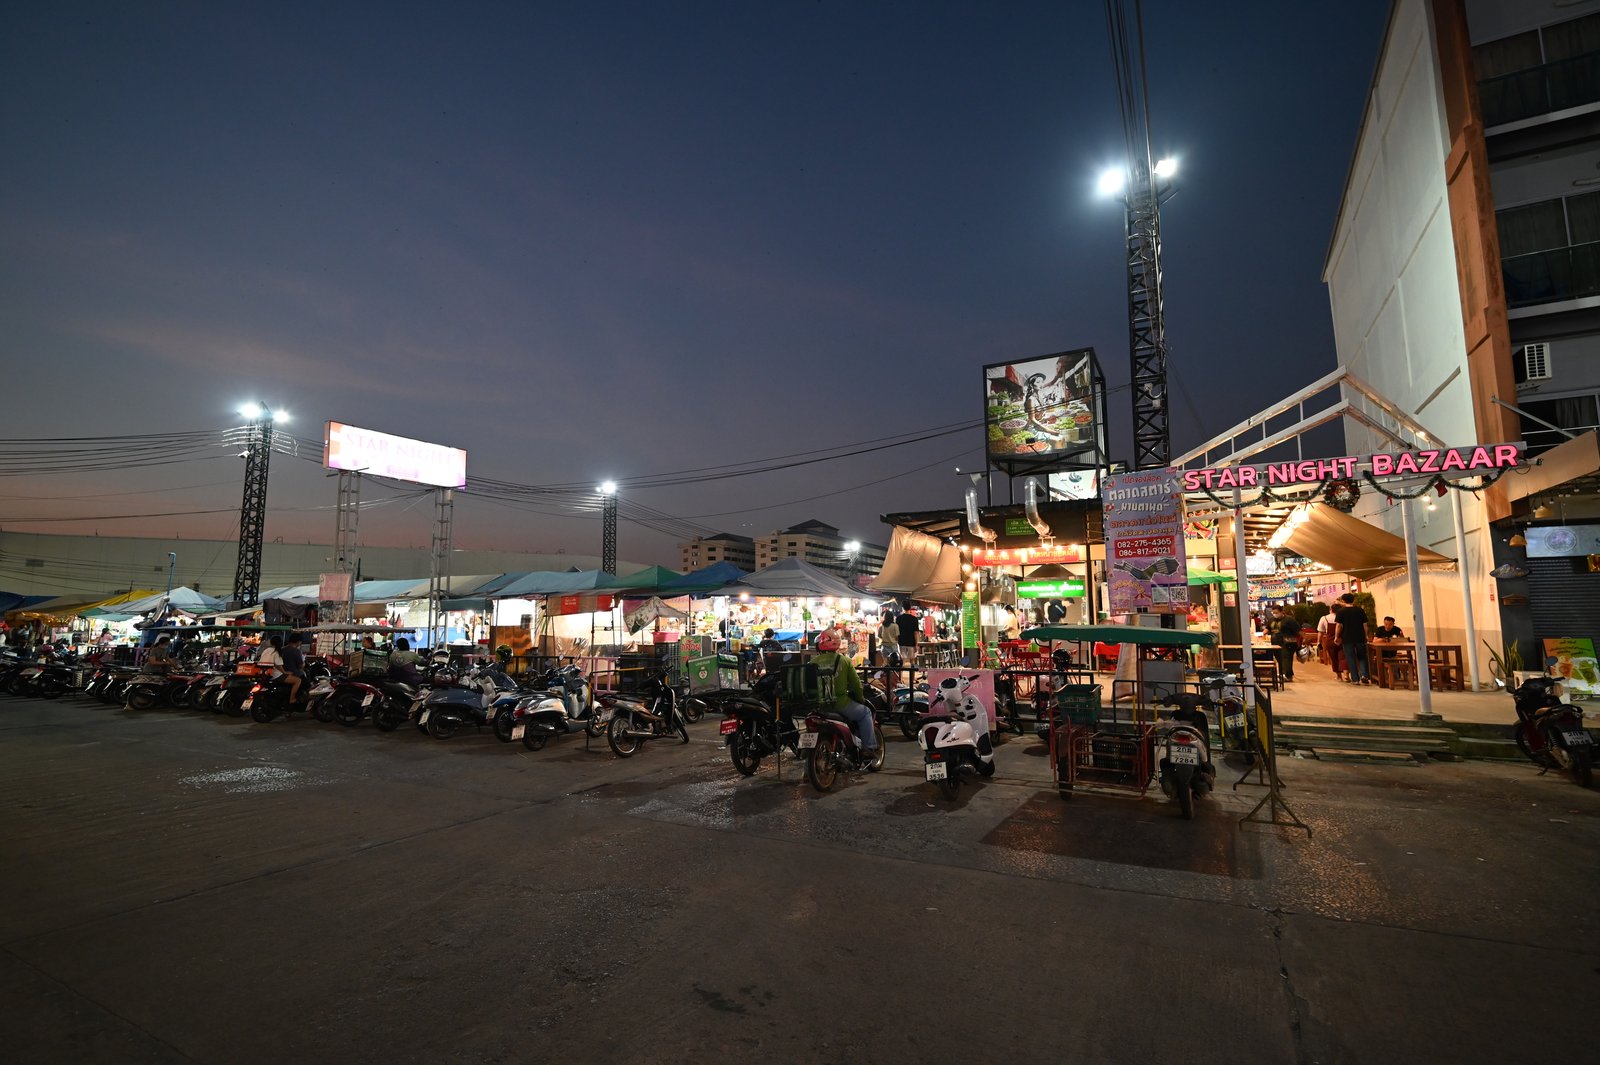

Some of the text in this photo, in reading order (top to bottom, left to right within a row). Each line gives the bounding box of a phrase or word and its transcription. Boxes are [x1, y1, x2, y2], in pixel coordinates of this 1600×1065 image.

[346, 433, 456, 464] STAR NIGHT
[1184, 444, 1519, 491] STAR NIGHT BAZAAR
[1109, 479, 1171, 501] ตลาดสตาร์
[1121, 501, 1164, 514] มาบตาพุด
[1117, 537, 1172, 549] 082-275-4365
[1118, 546, 1171, 557] 086-817-9021
